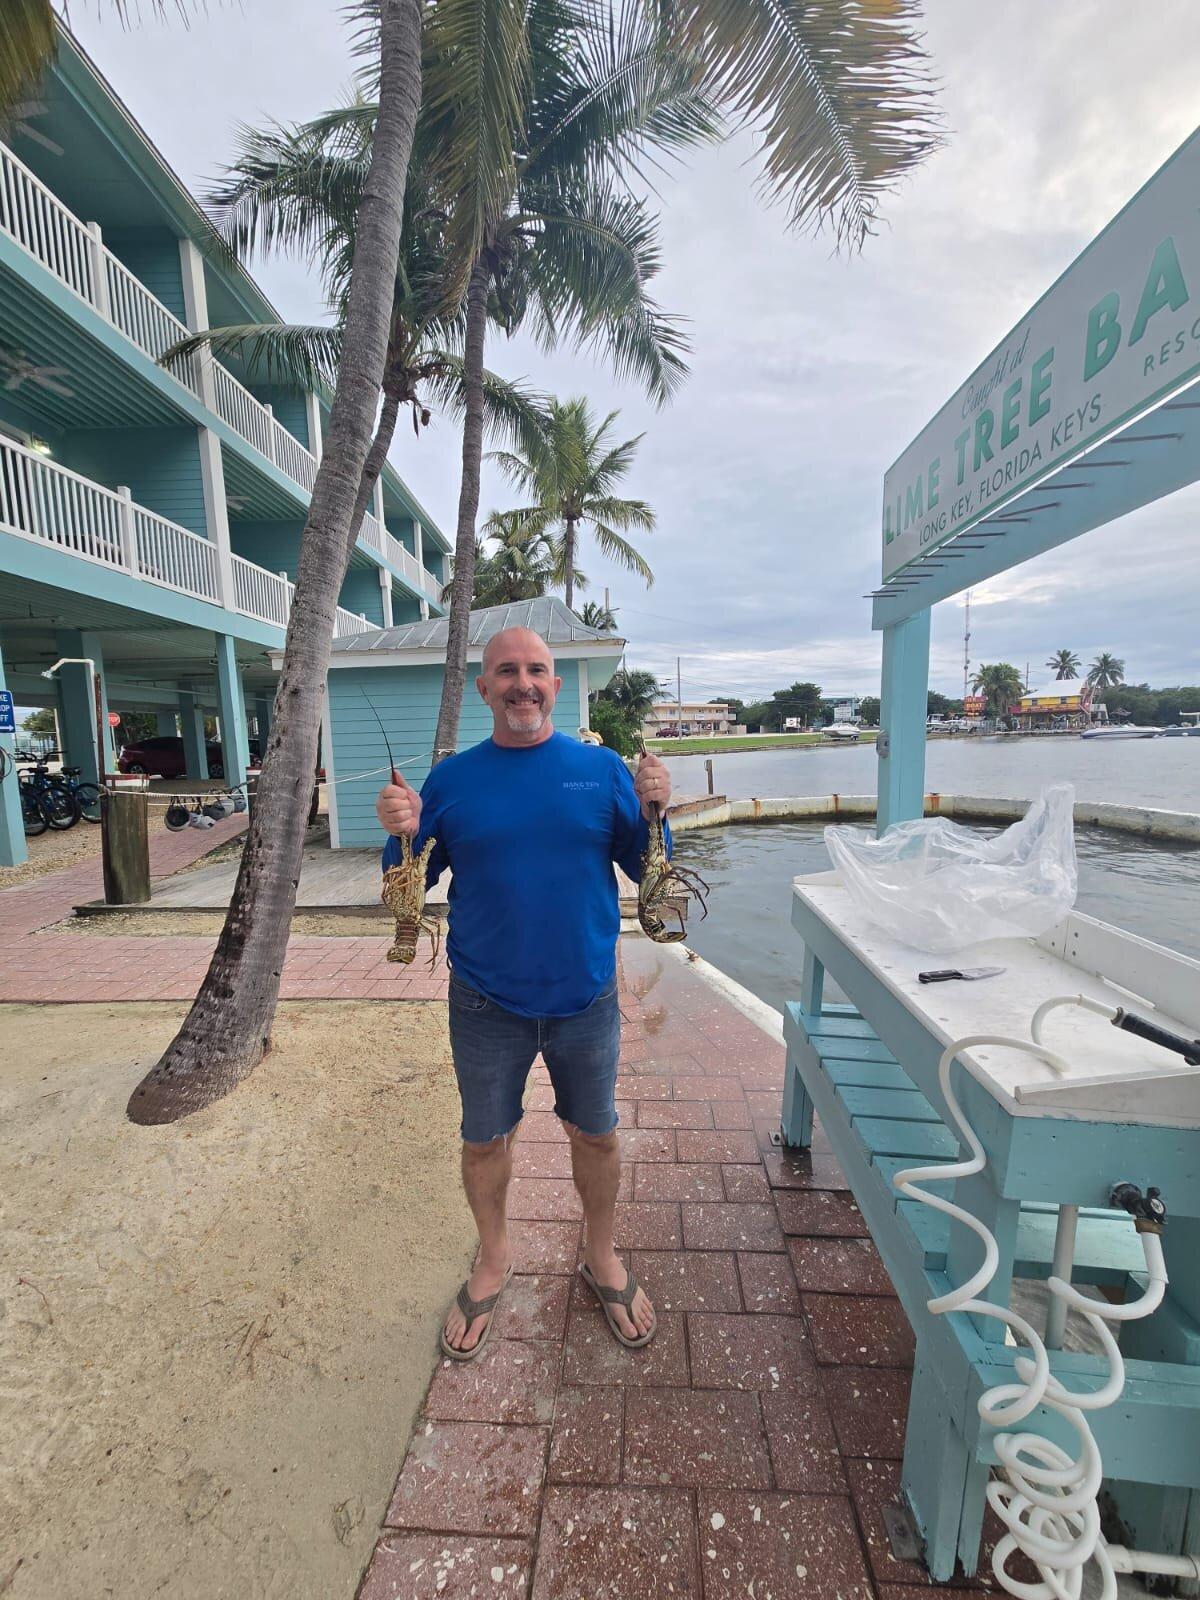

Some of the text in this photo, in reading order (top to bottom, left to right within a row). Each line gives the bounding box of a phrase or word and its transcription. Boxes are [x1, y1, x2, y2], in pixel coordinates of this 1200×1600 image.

[885, 234, 1200, 546] LIME TREE BA
[919, 393, 1102, 546] LONG KEY, FLORIDA KEYS
